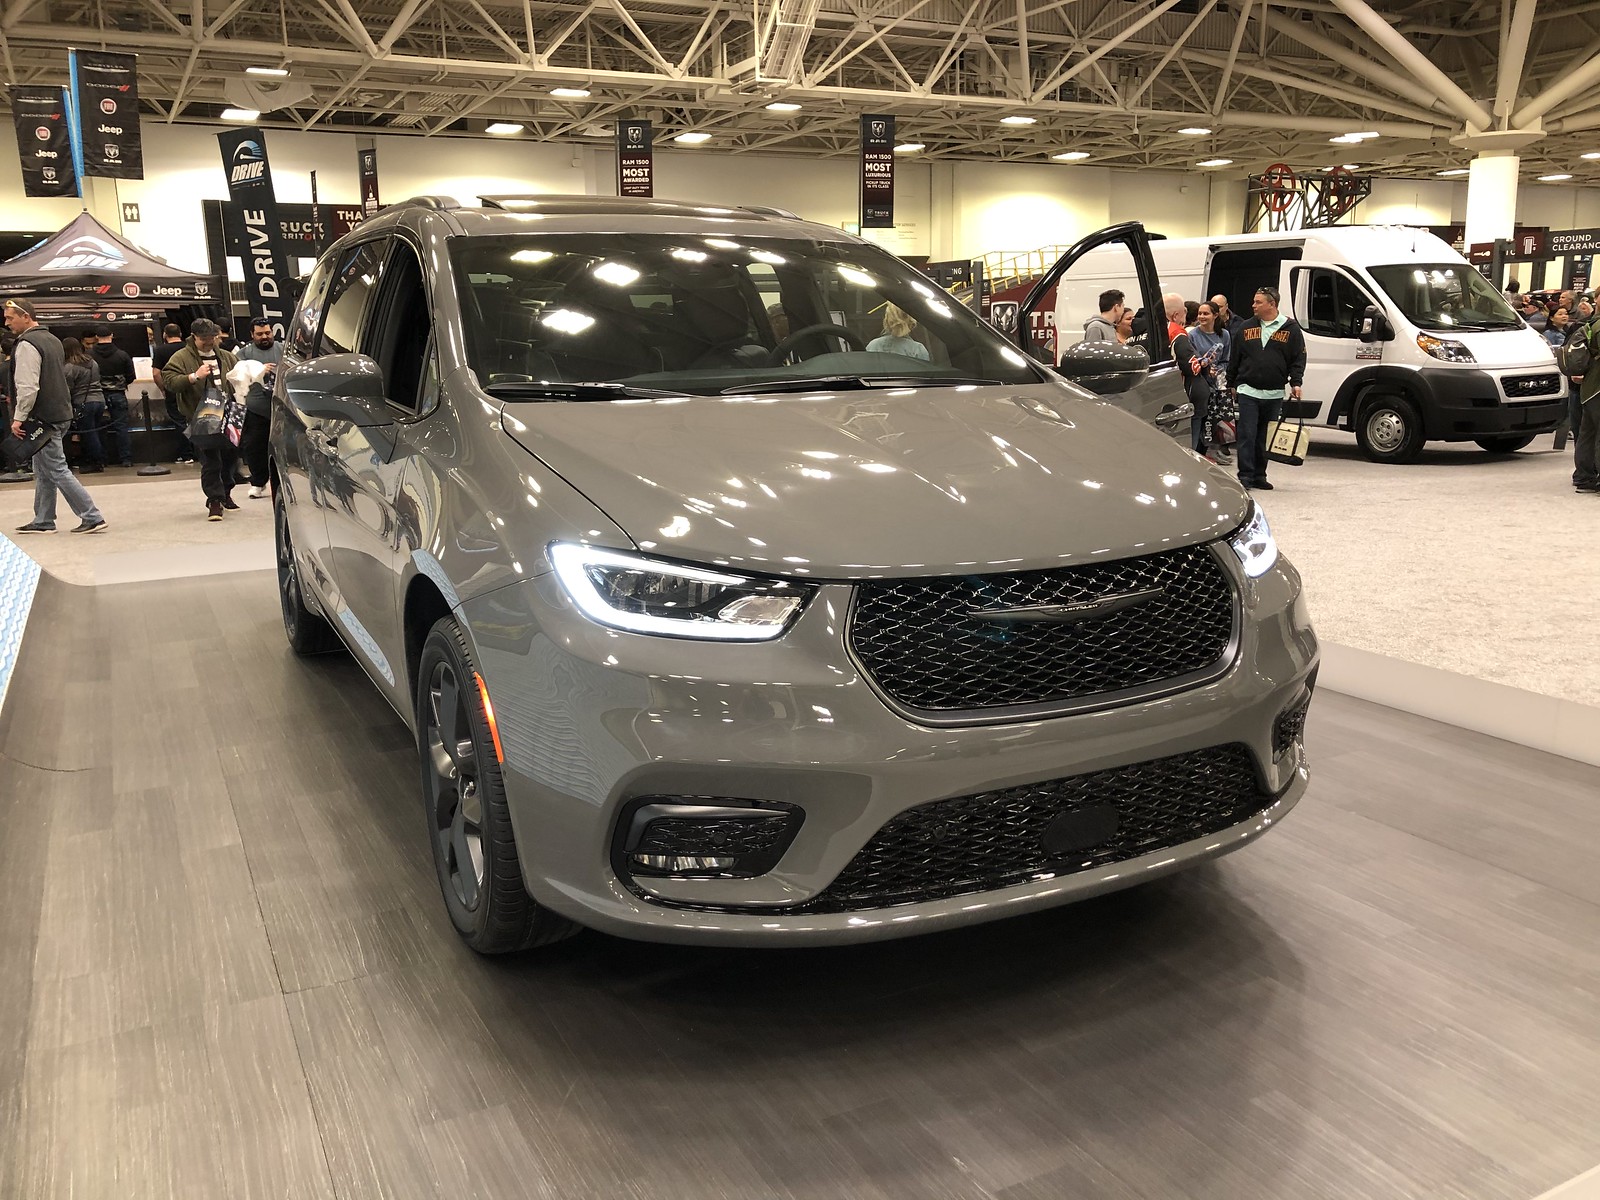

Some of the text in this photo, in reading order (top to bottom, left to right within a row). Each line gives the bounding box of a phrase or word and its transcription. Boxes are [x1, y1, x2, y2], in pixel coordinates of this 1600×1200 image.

[98, 124, 123, 135] Jeep
[35, 149, 58, 159] Jeep
[231, 161, 265, 182] DRIVE
[622, 168, 650, 177] MOST
[865, 162, 892, 172] MOST
[1552, 234, 1592, 243] GROUND
[243, 208, 280, 299] DRIVE
[153, 285, 182, 296] Jeep
[204, 397, 221, 406] Jeep
[30, 427, 44, 441] Jeep
[1204, 420, 1213, 442] Jeep
